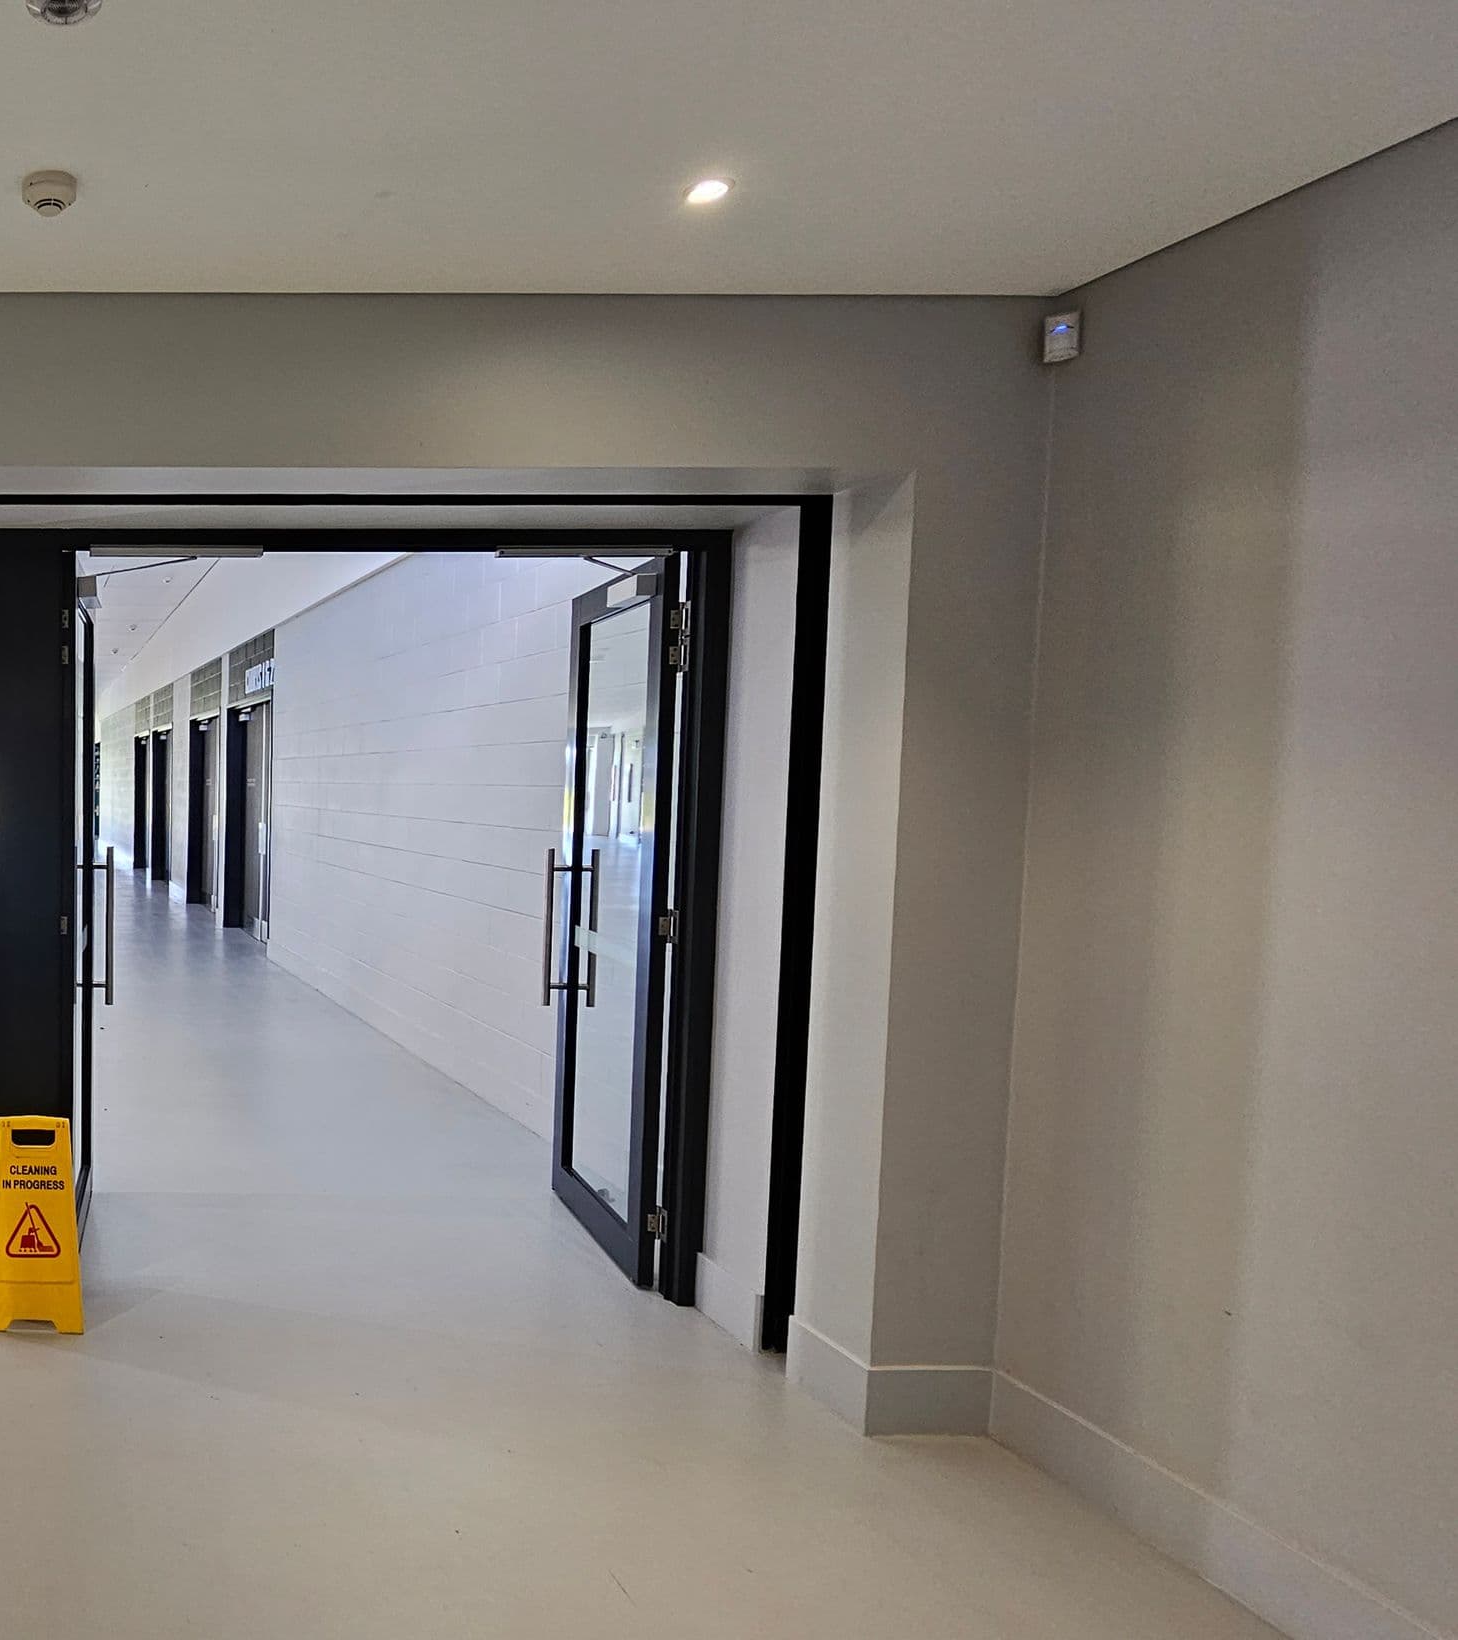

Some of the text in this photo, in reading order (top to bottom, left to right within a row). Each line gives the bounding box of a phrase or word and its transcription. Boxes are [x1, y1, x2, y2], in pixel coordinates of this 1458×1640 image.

[9, 1165, 57, 1176] CLEANING
[2, 1179, 65, 1190] IN PROGRESS
